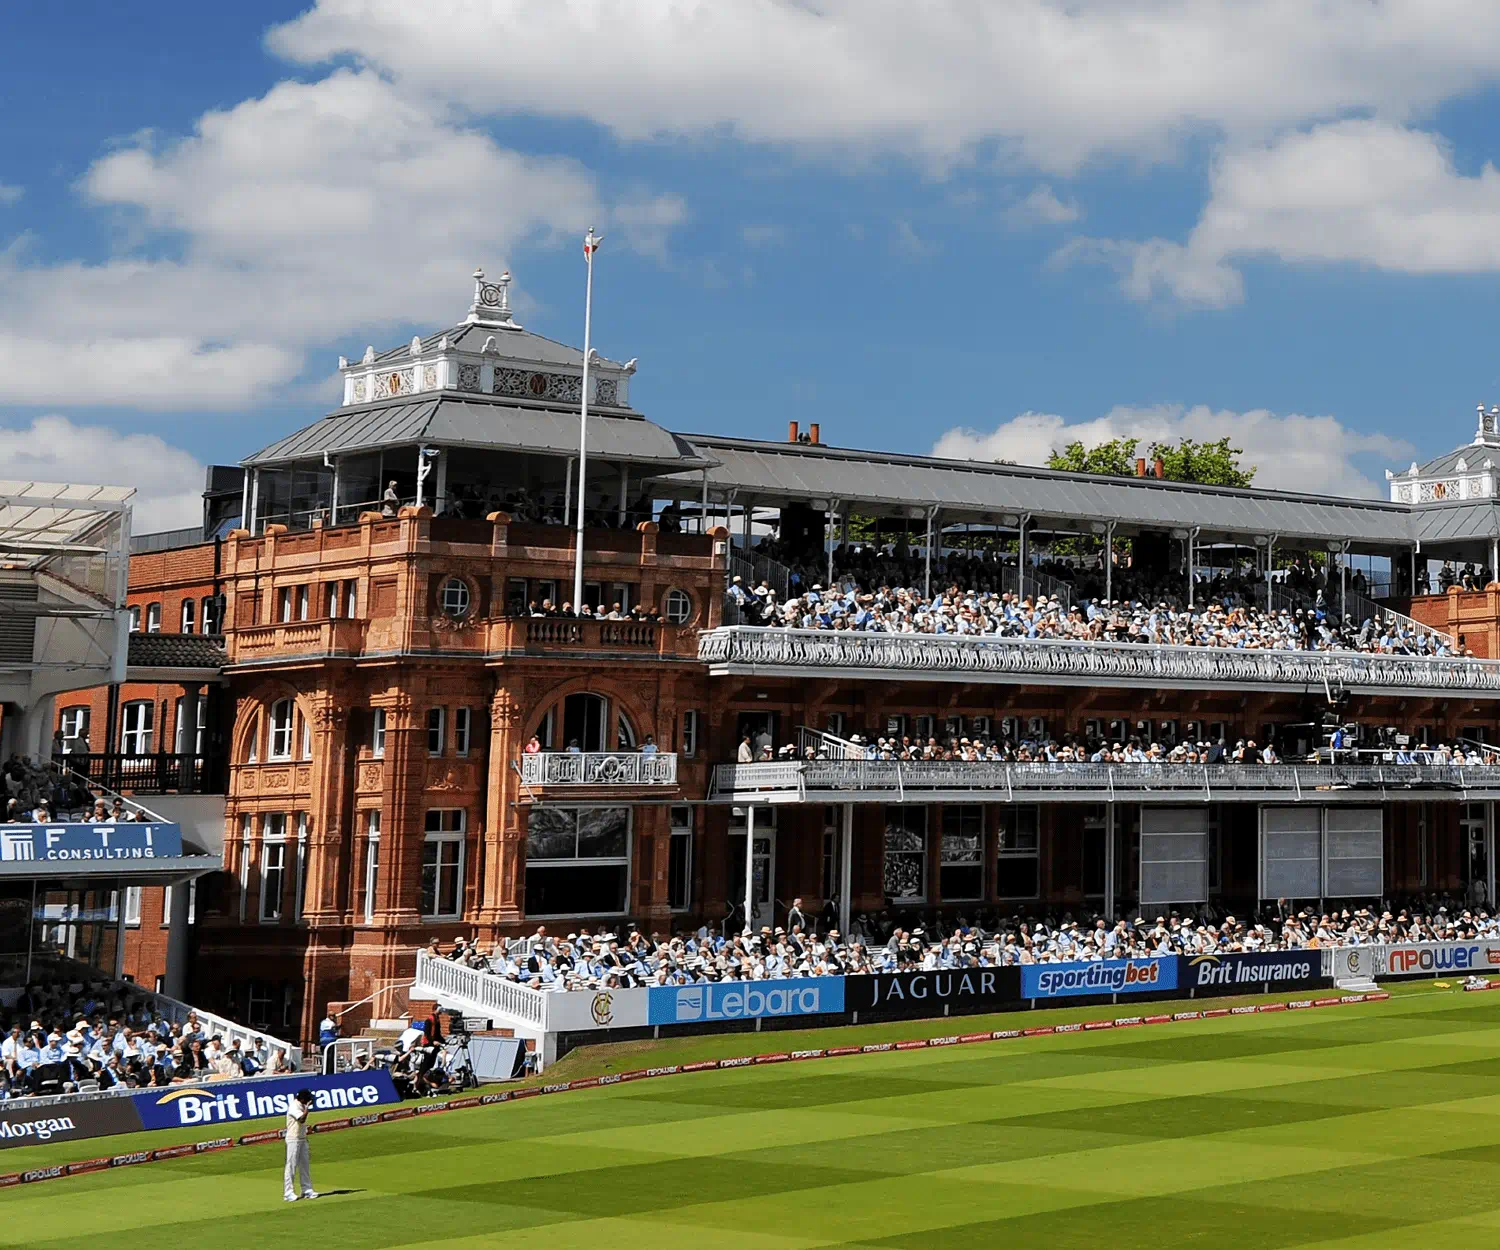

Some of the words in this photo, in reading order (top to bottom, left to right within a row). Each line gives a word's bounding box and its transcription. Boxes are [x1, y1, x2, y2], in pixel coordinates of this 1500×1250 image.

[47, 848, 155, 861] CONSULTING
[1198, 956, 1232, 987] Brit
[1234, 960, 1310, 984] Insurance
[1389, 946, 1480, 972] npower
[871, 971, 997, 1007] JAGUAR
[1038, 959, 1160, 995] sportingbet
[705, 984, 820, 1018] Lebara
[178, 1093, 242, 1124] Brit
[247, 1084, 379, 1117] Insance
